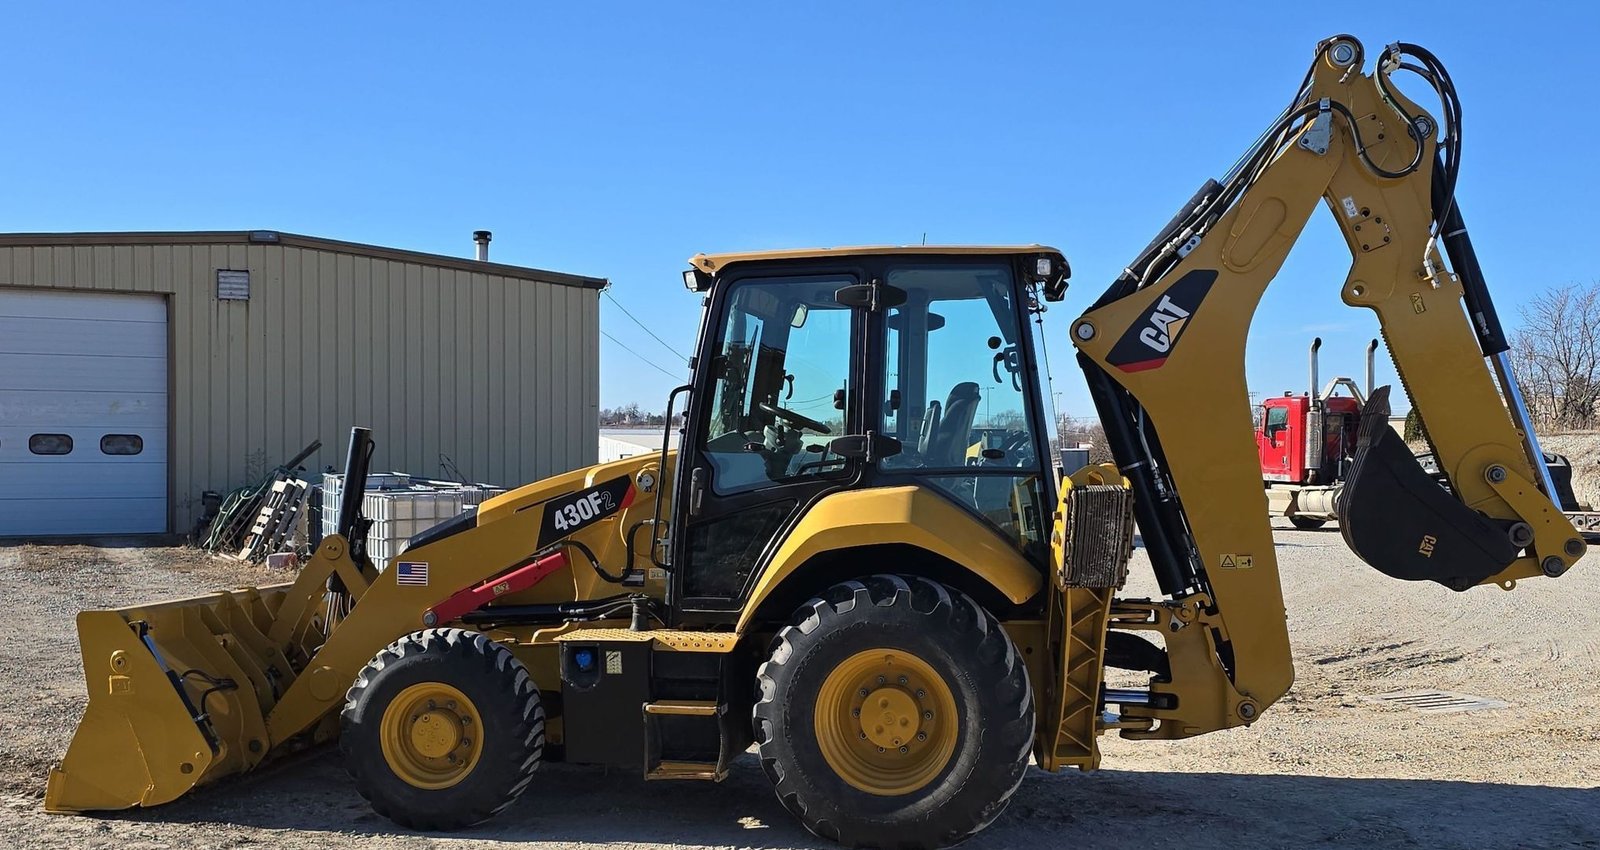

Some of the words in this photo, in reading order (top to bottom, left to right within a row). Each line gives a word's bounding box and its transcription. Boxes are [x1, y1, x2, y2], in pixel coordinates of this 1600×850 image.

[1139, 294, 1190, 353] CAT
[554, 491, 616, 531] 430F2
[1418, 535, 1437, 558] CAT
